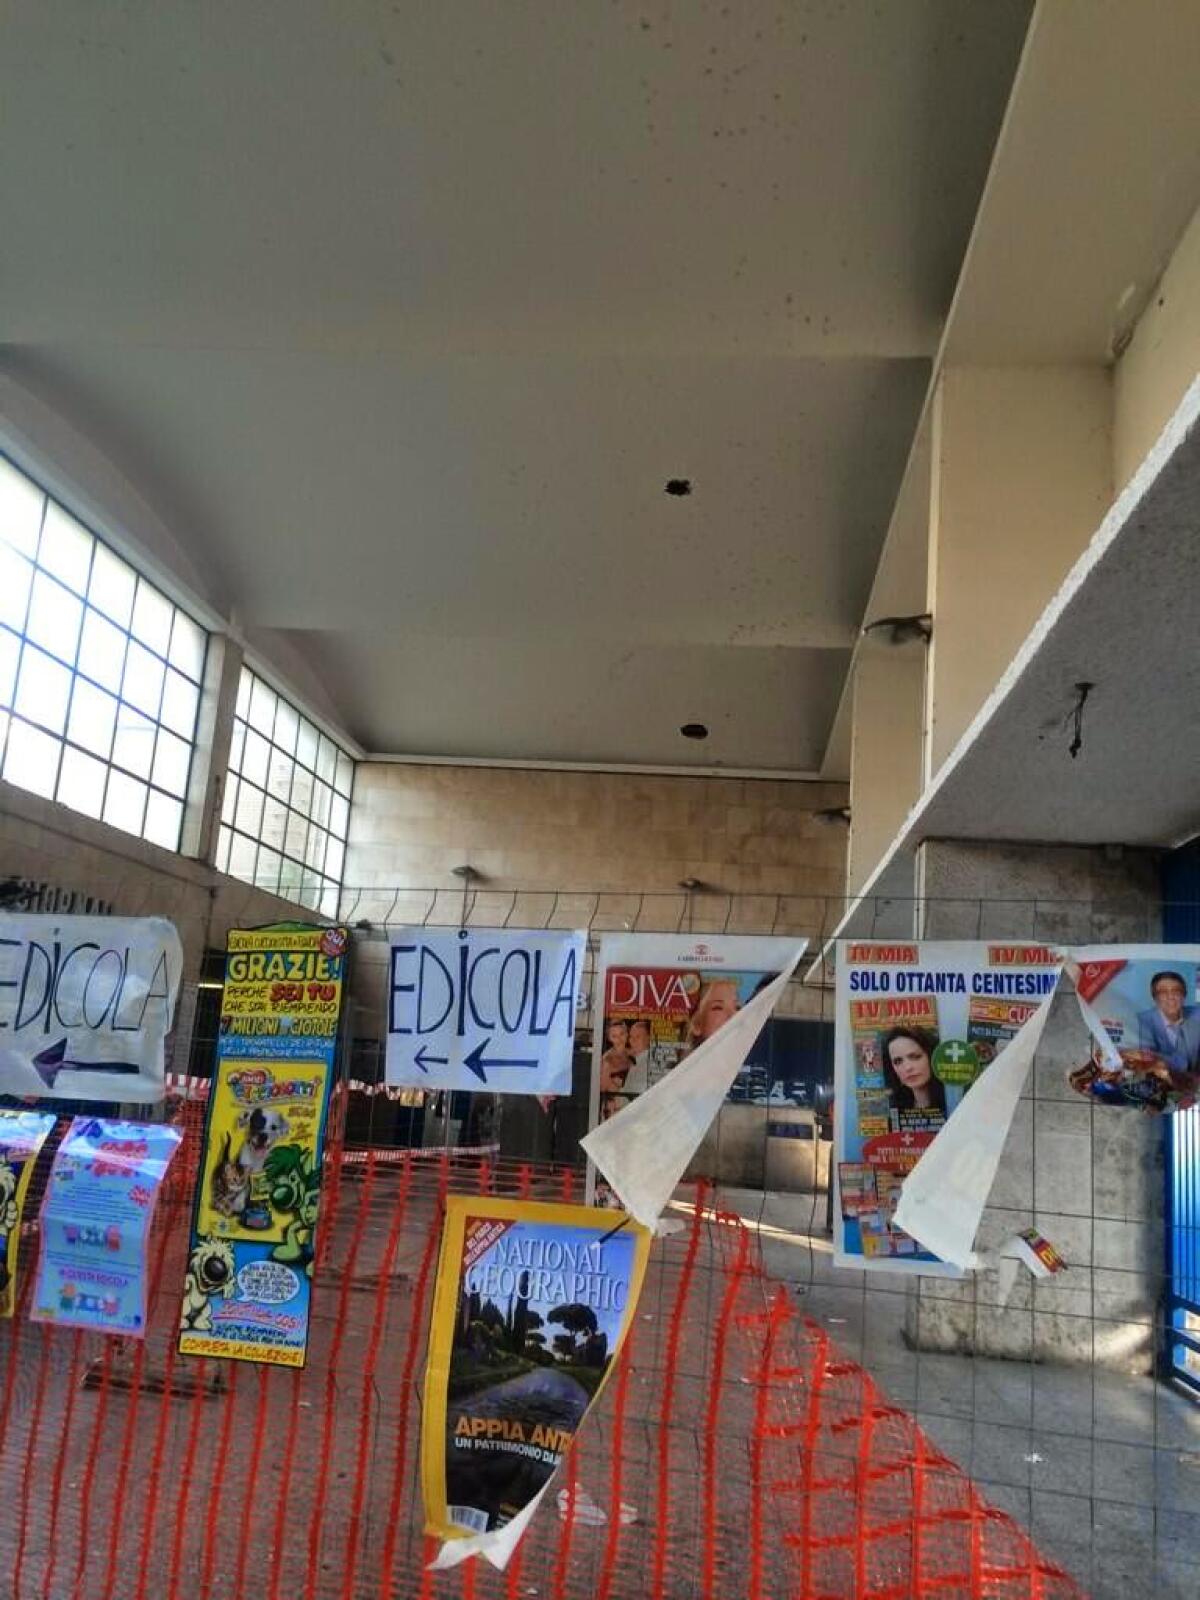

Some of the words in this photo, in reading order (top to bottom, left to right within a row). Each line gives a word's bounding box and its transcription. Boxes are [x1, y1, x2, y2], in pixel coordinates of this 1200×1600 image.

[849, 945, 873, 962] TV
[876, 945, 915, 963] MIA
[992, 947, 1016, 964] TV
[228, 951, 341, 981] GRAZIE!
[270, 983, 304, 1002] SEI
[307, 983, 338, 1001] TU
[611, 973, 692, 1009] DIVA
[850, 971, 890, 991] SOLO
[896, 972, 967, 993] OTTANTA
[224, 1001, 245, 1013] CHE
[271, 1002, 338, 1014] RIEMPIENDO
[855, 1002, 880, 1019] TV
[887, 999, 930, 1017] MIA
[231, 1017, 279, 1035] MILIONI
[493, 1237, 608, 1277] NATIONAL
[464, 1263, 625, 1312] GEOGRAPHIC
[455, 1415, 526, 1442] APPIA
[455, 1437, 472, 1449] UN
[474, 1440, 542, 1461] PATRIMONIO
